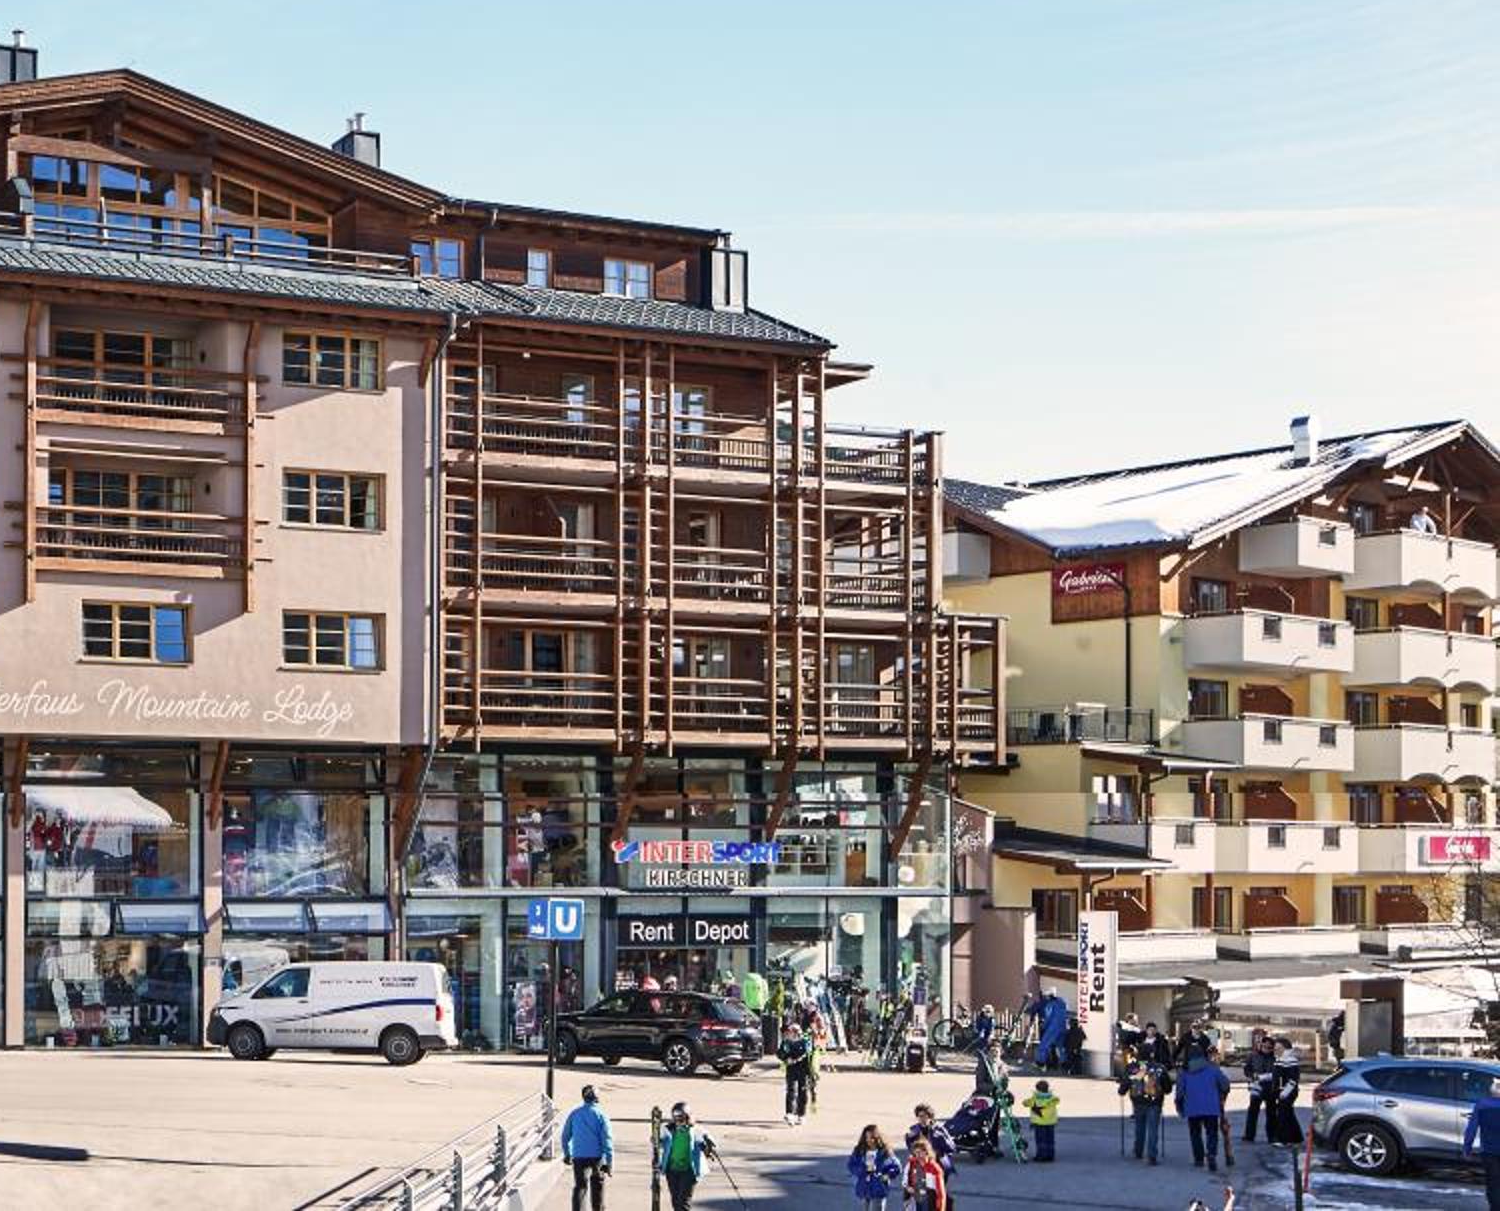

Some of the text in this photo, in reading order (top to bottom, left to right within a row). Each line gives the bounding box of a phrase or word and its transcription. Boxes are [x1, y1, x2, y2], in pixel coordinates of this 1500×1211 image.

[97, 680, 252, 720] Mountain
[263, 684, 354, 737] Lodge
[640, 840, 782, 864] INTERSPORT
[646, 868, 749, 888] KIRSCHNER
[555, 905, 577, 933] U
[629, 921, 676, 941] Rent
[694, 920, 750, 944] Depot
[1089, 942, 1105, 1013] Rent
